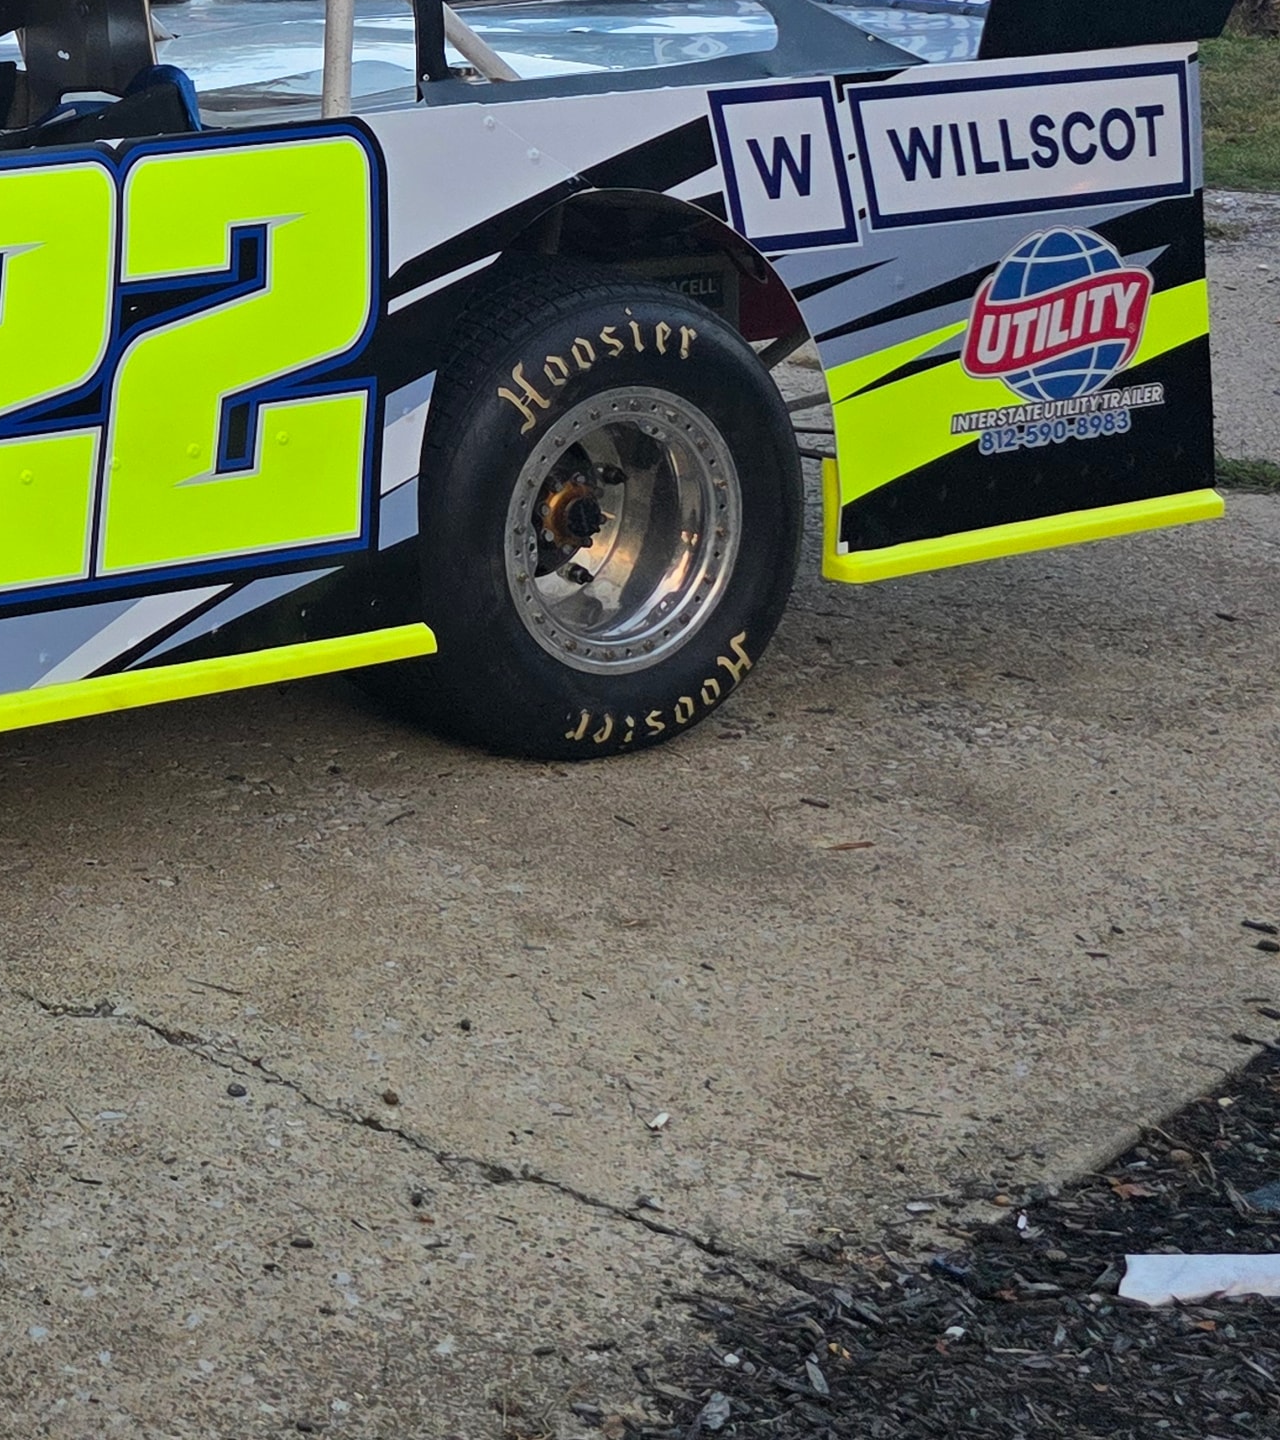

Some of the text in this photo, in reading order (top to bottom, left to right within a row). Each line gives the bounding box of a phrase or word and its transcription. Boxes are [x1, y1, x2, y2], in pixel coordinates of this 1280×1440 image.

[746, 133, 812, 200] W
[886, 104, 1166, 182] WILLSCOT
[976, 281, 1142, 365] UTILITY
[497, 307, 698, 436] Hoosier
[951, 385, 1164, 434] INTERSTATE UTILITY TRAILER
[981, 410, 1130, 452] 812-590-8983
[564, 630, 754, 745] Hoosier
